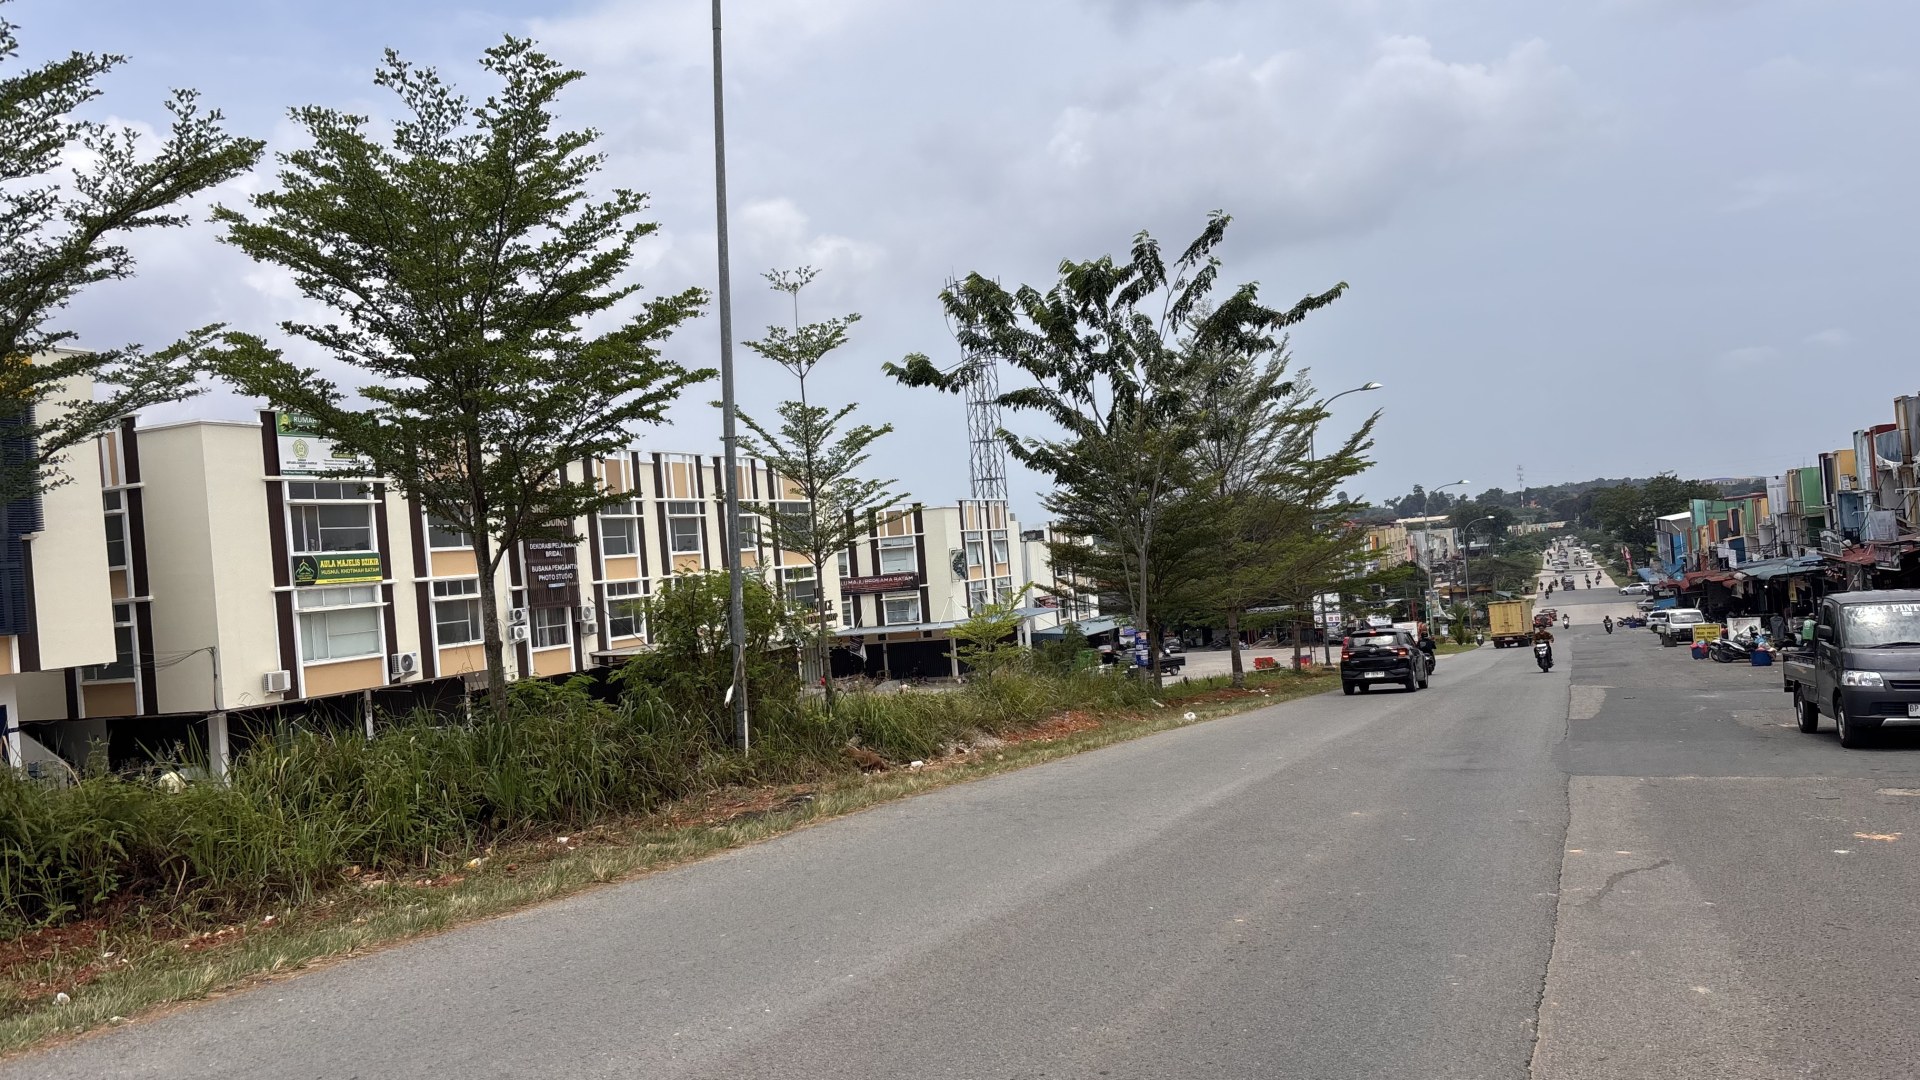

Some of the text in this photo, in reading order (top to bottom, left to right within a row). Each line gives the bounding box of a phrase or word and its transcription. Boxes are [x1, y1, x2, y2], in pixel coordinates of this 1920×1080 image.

[293, 416, 317, 424] RUMAH
[545, 550, 563, 558] BRIDAL
[320, 558, 379, 568] AULA MAJELIS DZIKIR
[531, 565, 552, 573] BUSANA
